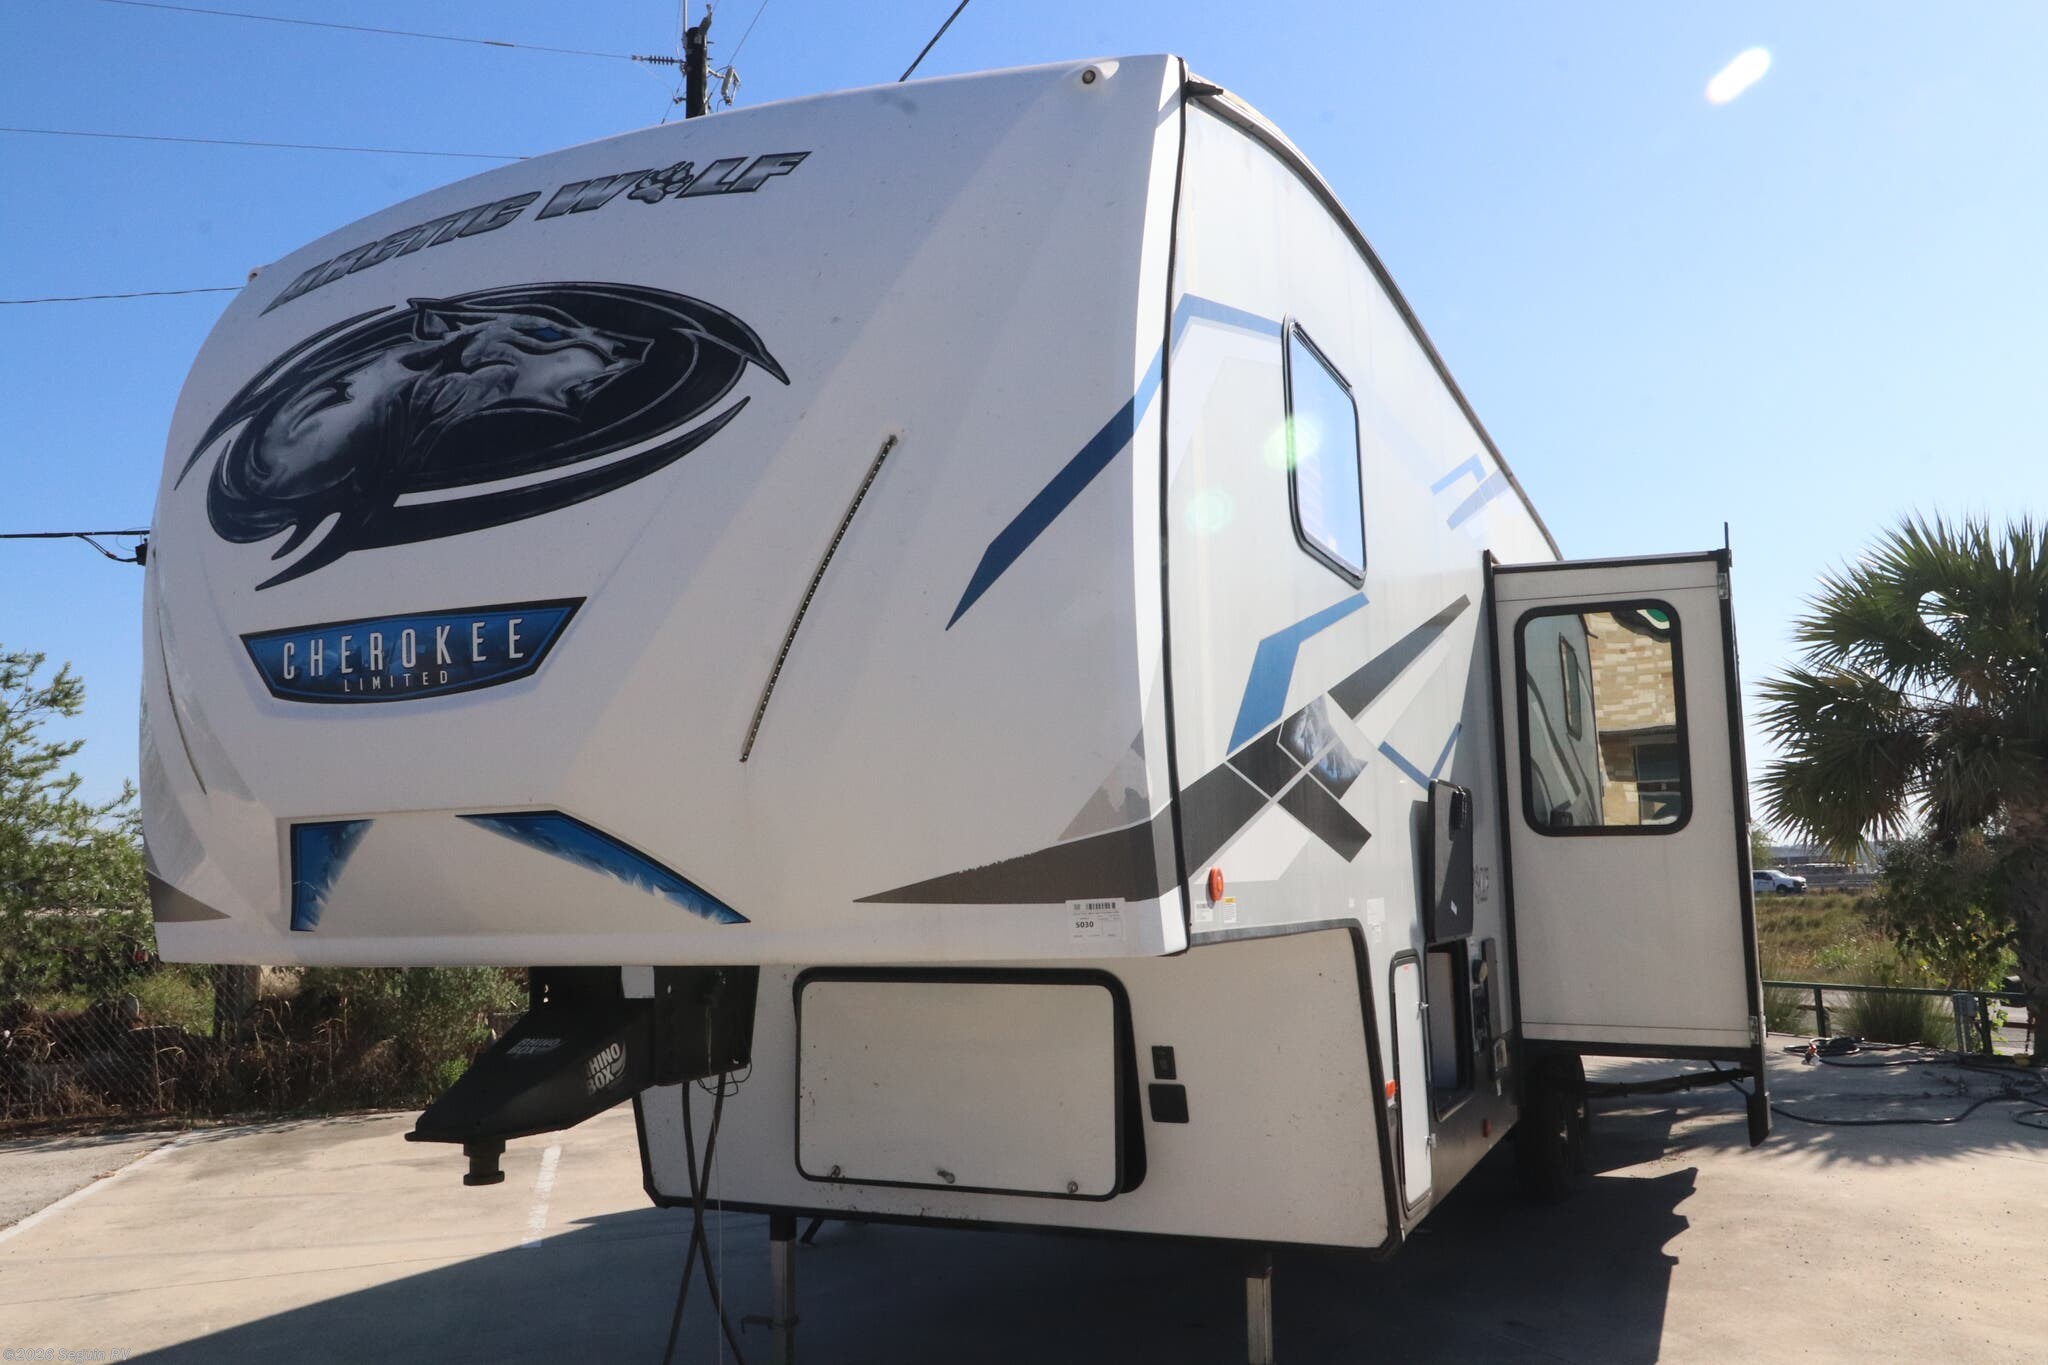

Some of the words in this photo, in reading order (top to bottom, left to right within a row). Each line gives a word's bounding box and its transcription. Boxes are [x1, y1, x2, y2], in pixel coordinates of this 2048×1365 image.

[258, 191, 542, 317] ARCTIC
[283, 618, 524, 679] CHEROKEE
[344, 670, 448, 692] LIMITED
